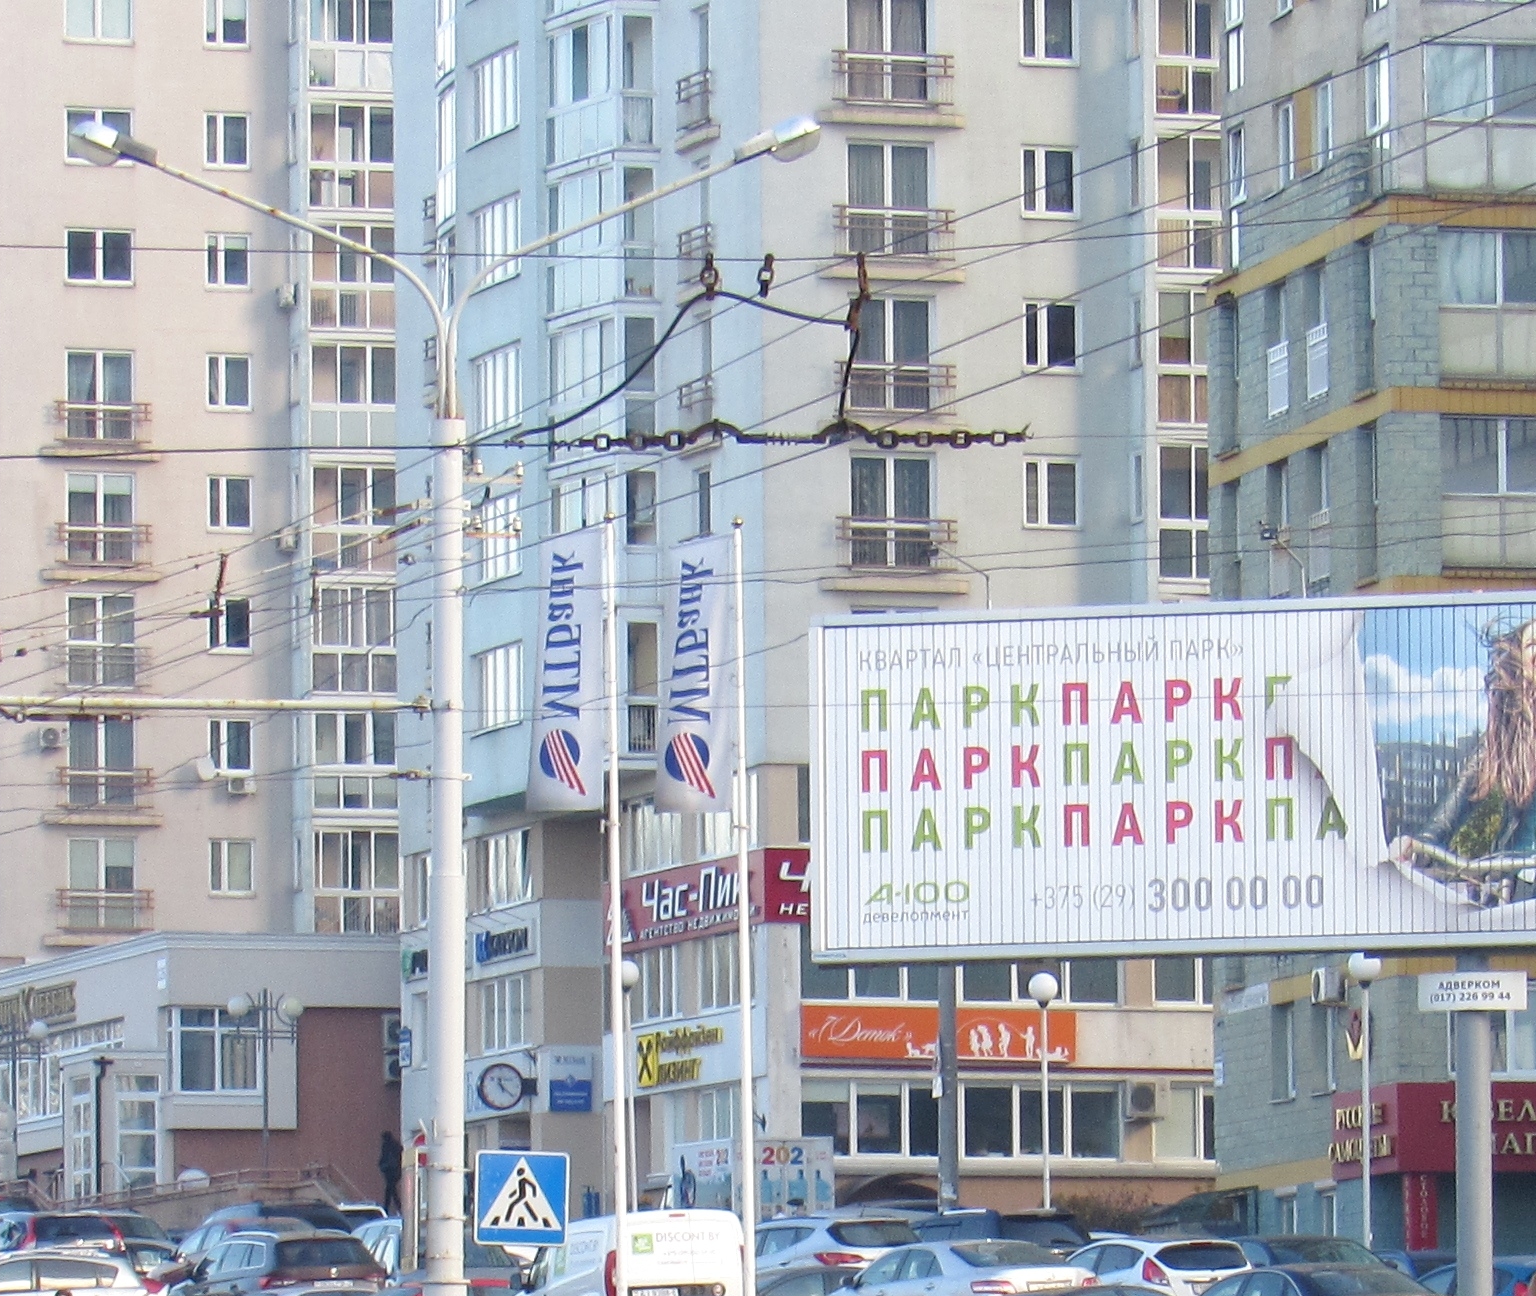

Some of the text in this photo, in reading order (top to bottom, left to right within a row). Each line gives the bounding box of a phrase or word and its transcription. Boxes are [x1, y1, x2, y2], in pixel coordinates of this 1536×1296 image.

[859, 637, 1244, 673] КВАРТАЛ «ЦЕНТРАЛЬНЫЙ ПАРК»
[1030, 884, 1083, 911] +375
[1092, 882, 1135, 913] (29)
[1148, 877, 1212, 913] 300
[1226, 876, 1267, 911] 00
[1280, 874, 1325, 909] 00
[687, 905, 758, 931] НЕДВИЖИМОИ
[863, 909, 970, 925] девелопмент
[1429, 991, 1456, 1004] (017)
[1482, 991, 1496, 1002] 99
[1498, 991, 1512, 1001] 44
[1438, 978, 1501, 991] АДВЕРКОМ
[1335, 1103, 1386, 1131] РУССКЕ
